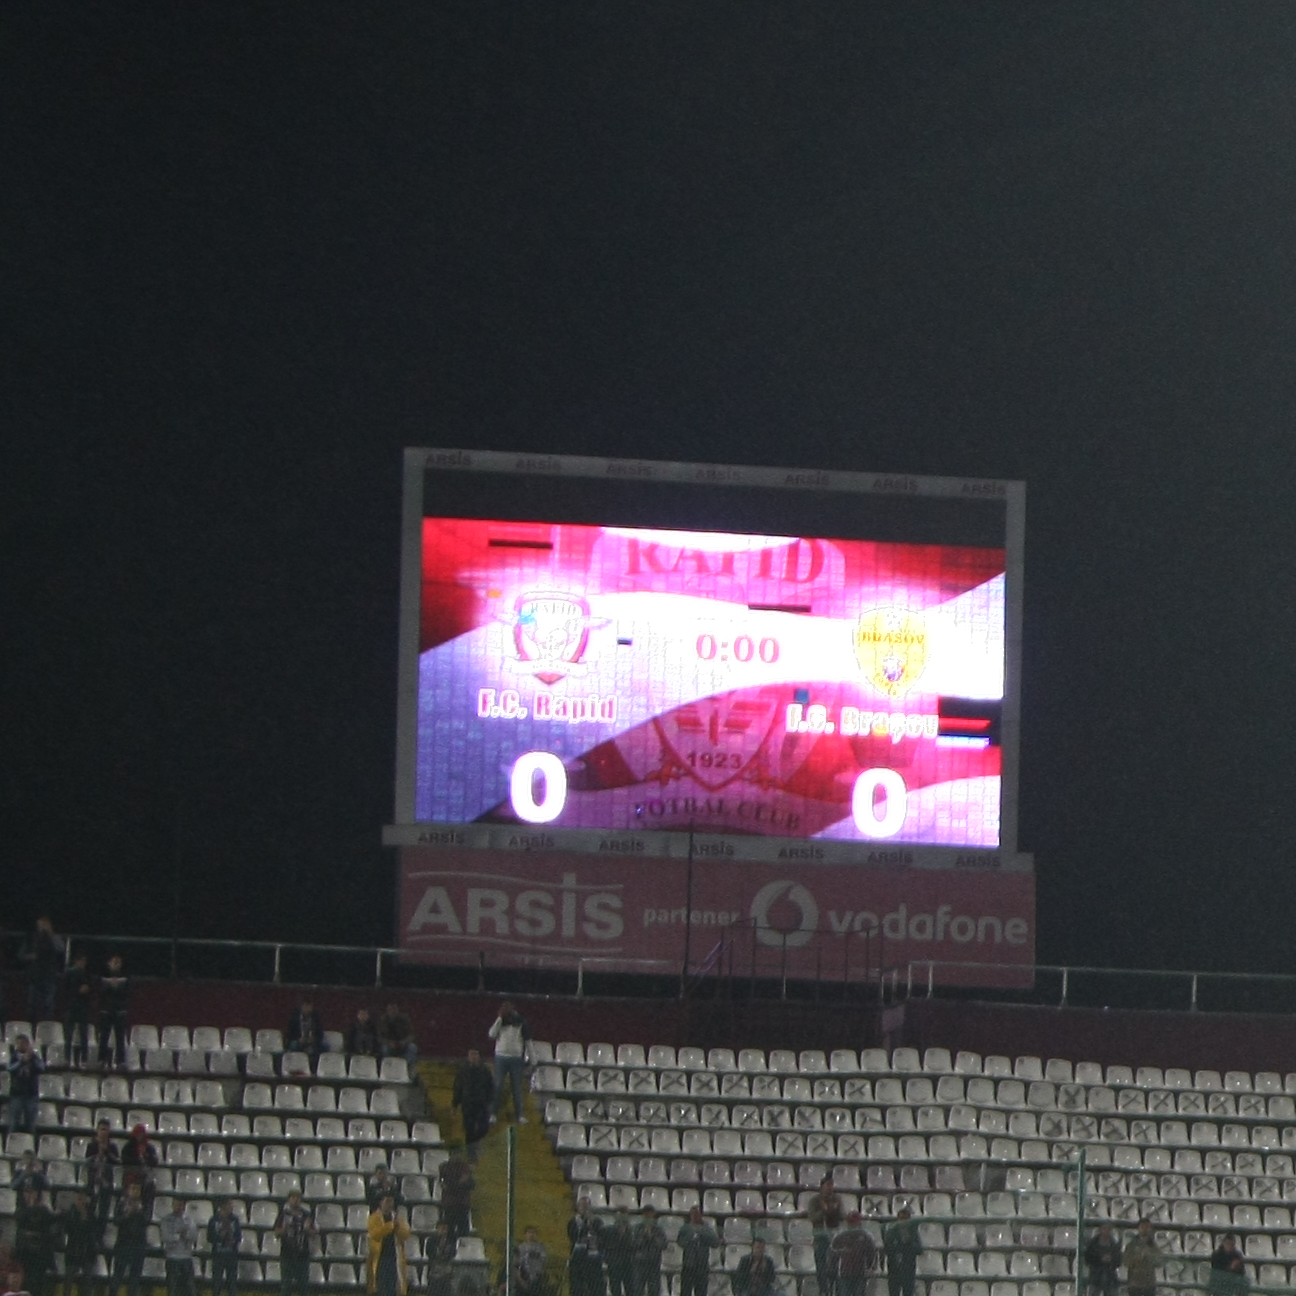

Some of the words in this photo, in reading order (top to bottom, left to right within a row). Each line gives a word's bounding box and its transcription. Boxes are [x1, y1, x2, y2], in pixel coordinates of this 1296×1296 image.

[696, 634, 780, 663] 0:00
[533, 692, 618, 725] Rapid
[686, 752, 742, 769] 1923
[510, 750, 568, 823] 0
[852, 767, 908, 838] 0
[643, 907, 740, 927] partener
[829, 902, 1029, 945] vodafone
